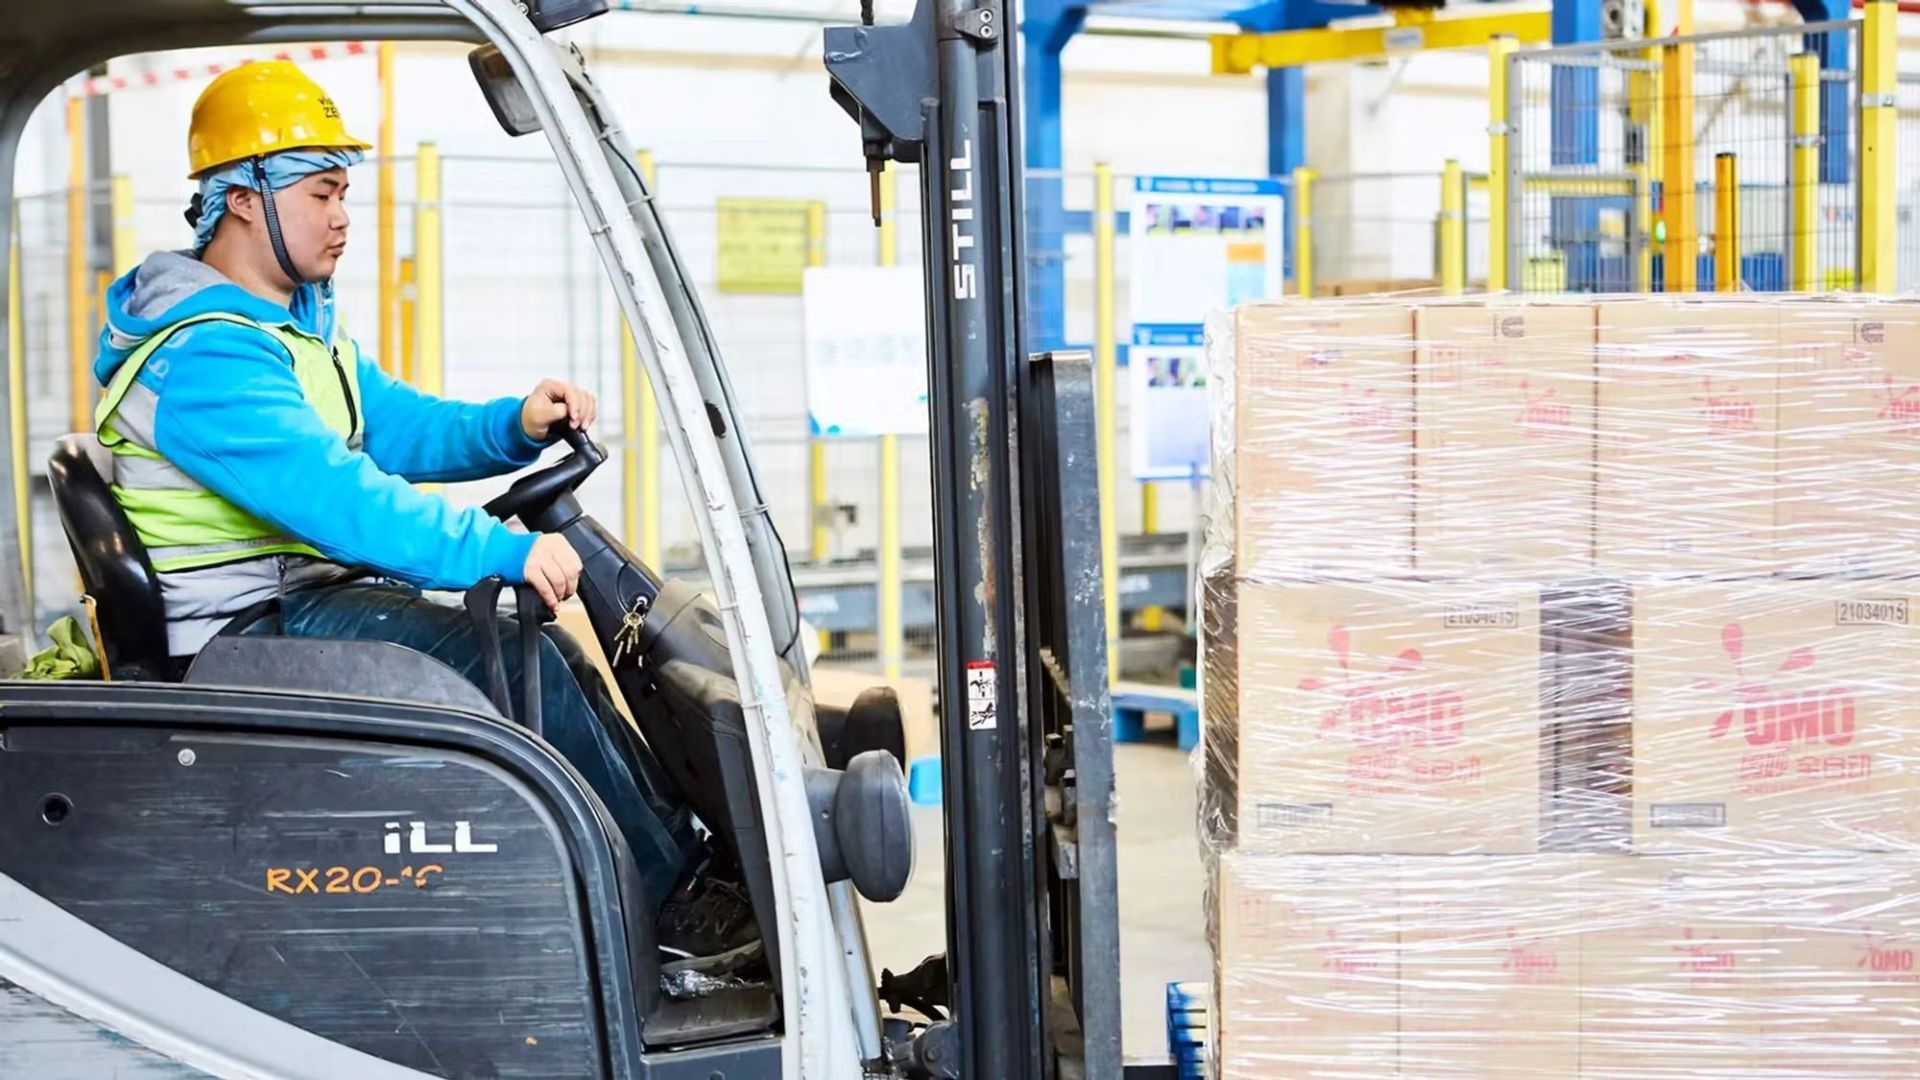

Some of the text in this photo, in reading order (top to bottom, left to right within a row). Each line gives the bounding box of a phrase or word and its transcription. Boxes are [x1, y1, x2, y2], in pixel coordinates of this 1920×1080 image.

[950, 139, 976, 299] STILL
[1839, 603, 1904, 621] 21034015
[1871, 949, 1914, 971] OMO
